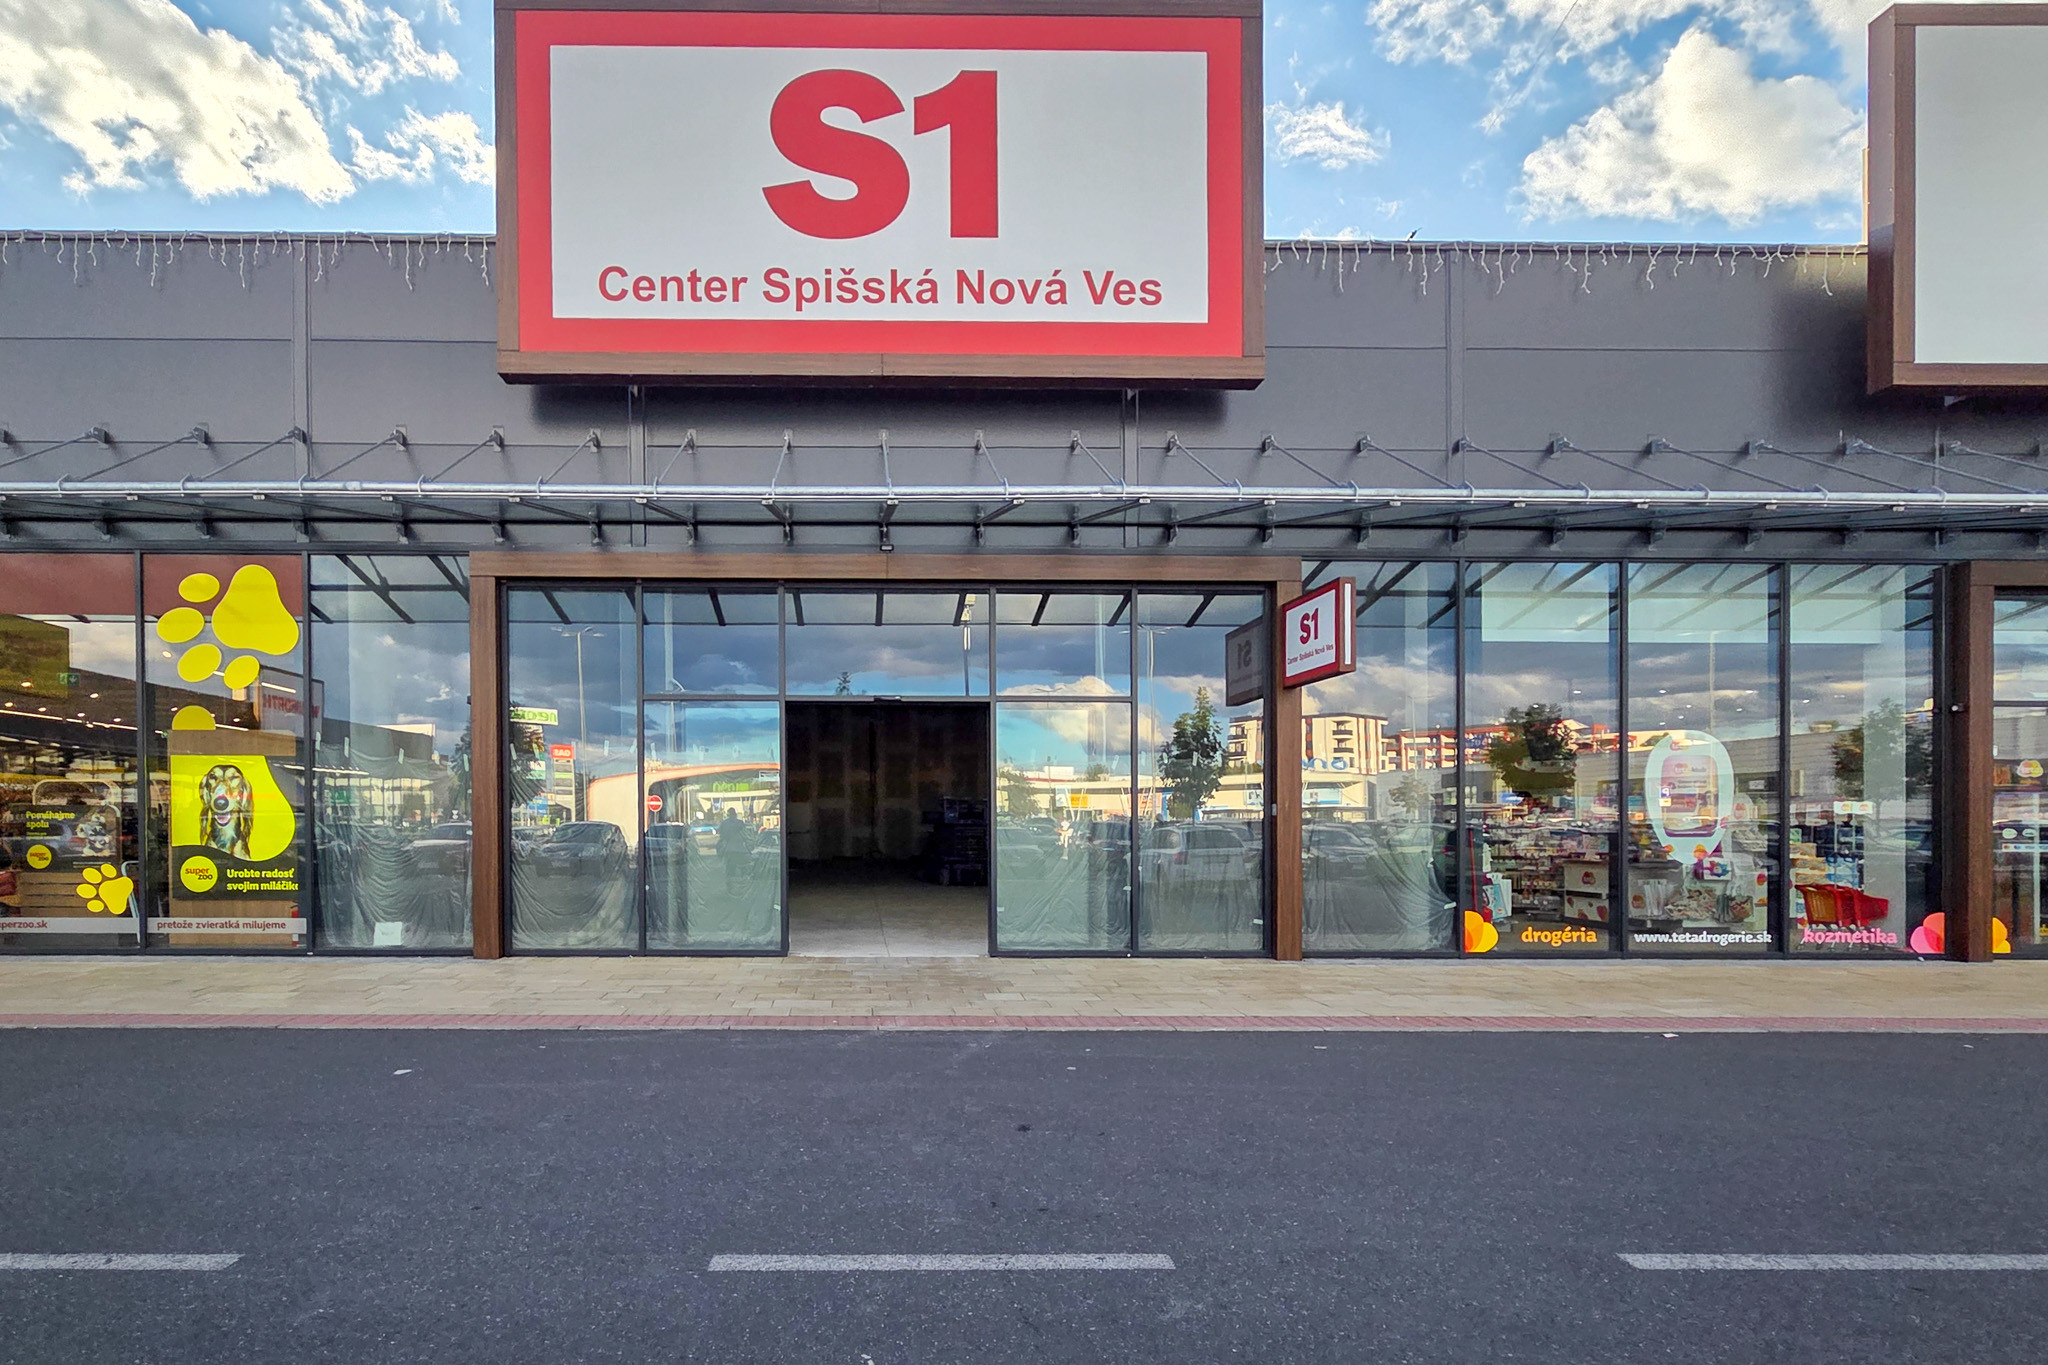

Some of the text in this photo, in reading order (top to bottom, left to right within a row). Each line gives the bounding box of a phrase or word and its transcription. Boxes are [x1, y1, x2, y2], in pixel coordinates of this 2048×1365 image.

[762, 68, 999, 239] S1
[599, 266, 1162, 311] Center Spišská Nová Ves
[1299, 608, 1318, 645] S1
[26, 820, 49, 829] spolu
[185, 867, 210, 876] super
[226, 868, 294, 878] Urobte radosť
[226, 881, 259, 892] svojim
[0, 920, 47, 930] perzoo.sk
[157, 919, 287, 930] pretože zvieratká milujeme
[1521, 926, 1598, 947] drogéria
[1634, 930, 1773, 946] www.tetadrogerie.sk
[1803, 927, 1898, 944] kozmetika
